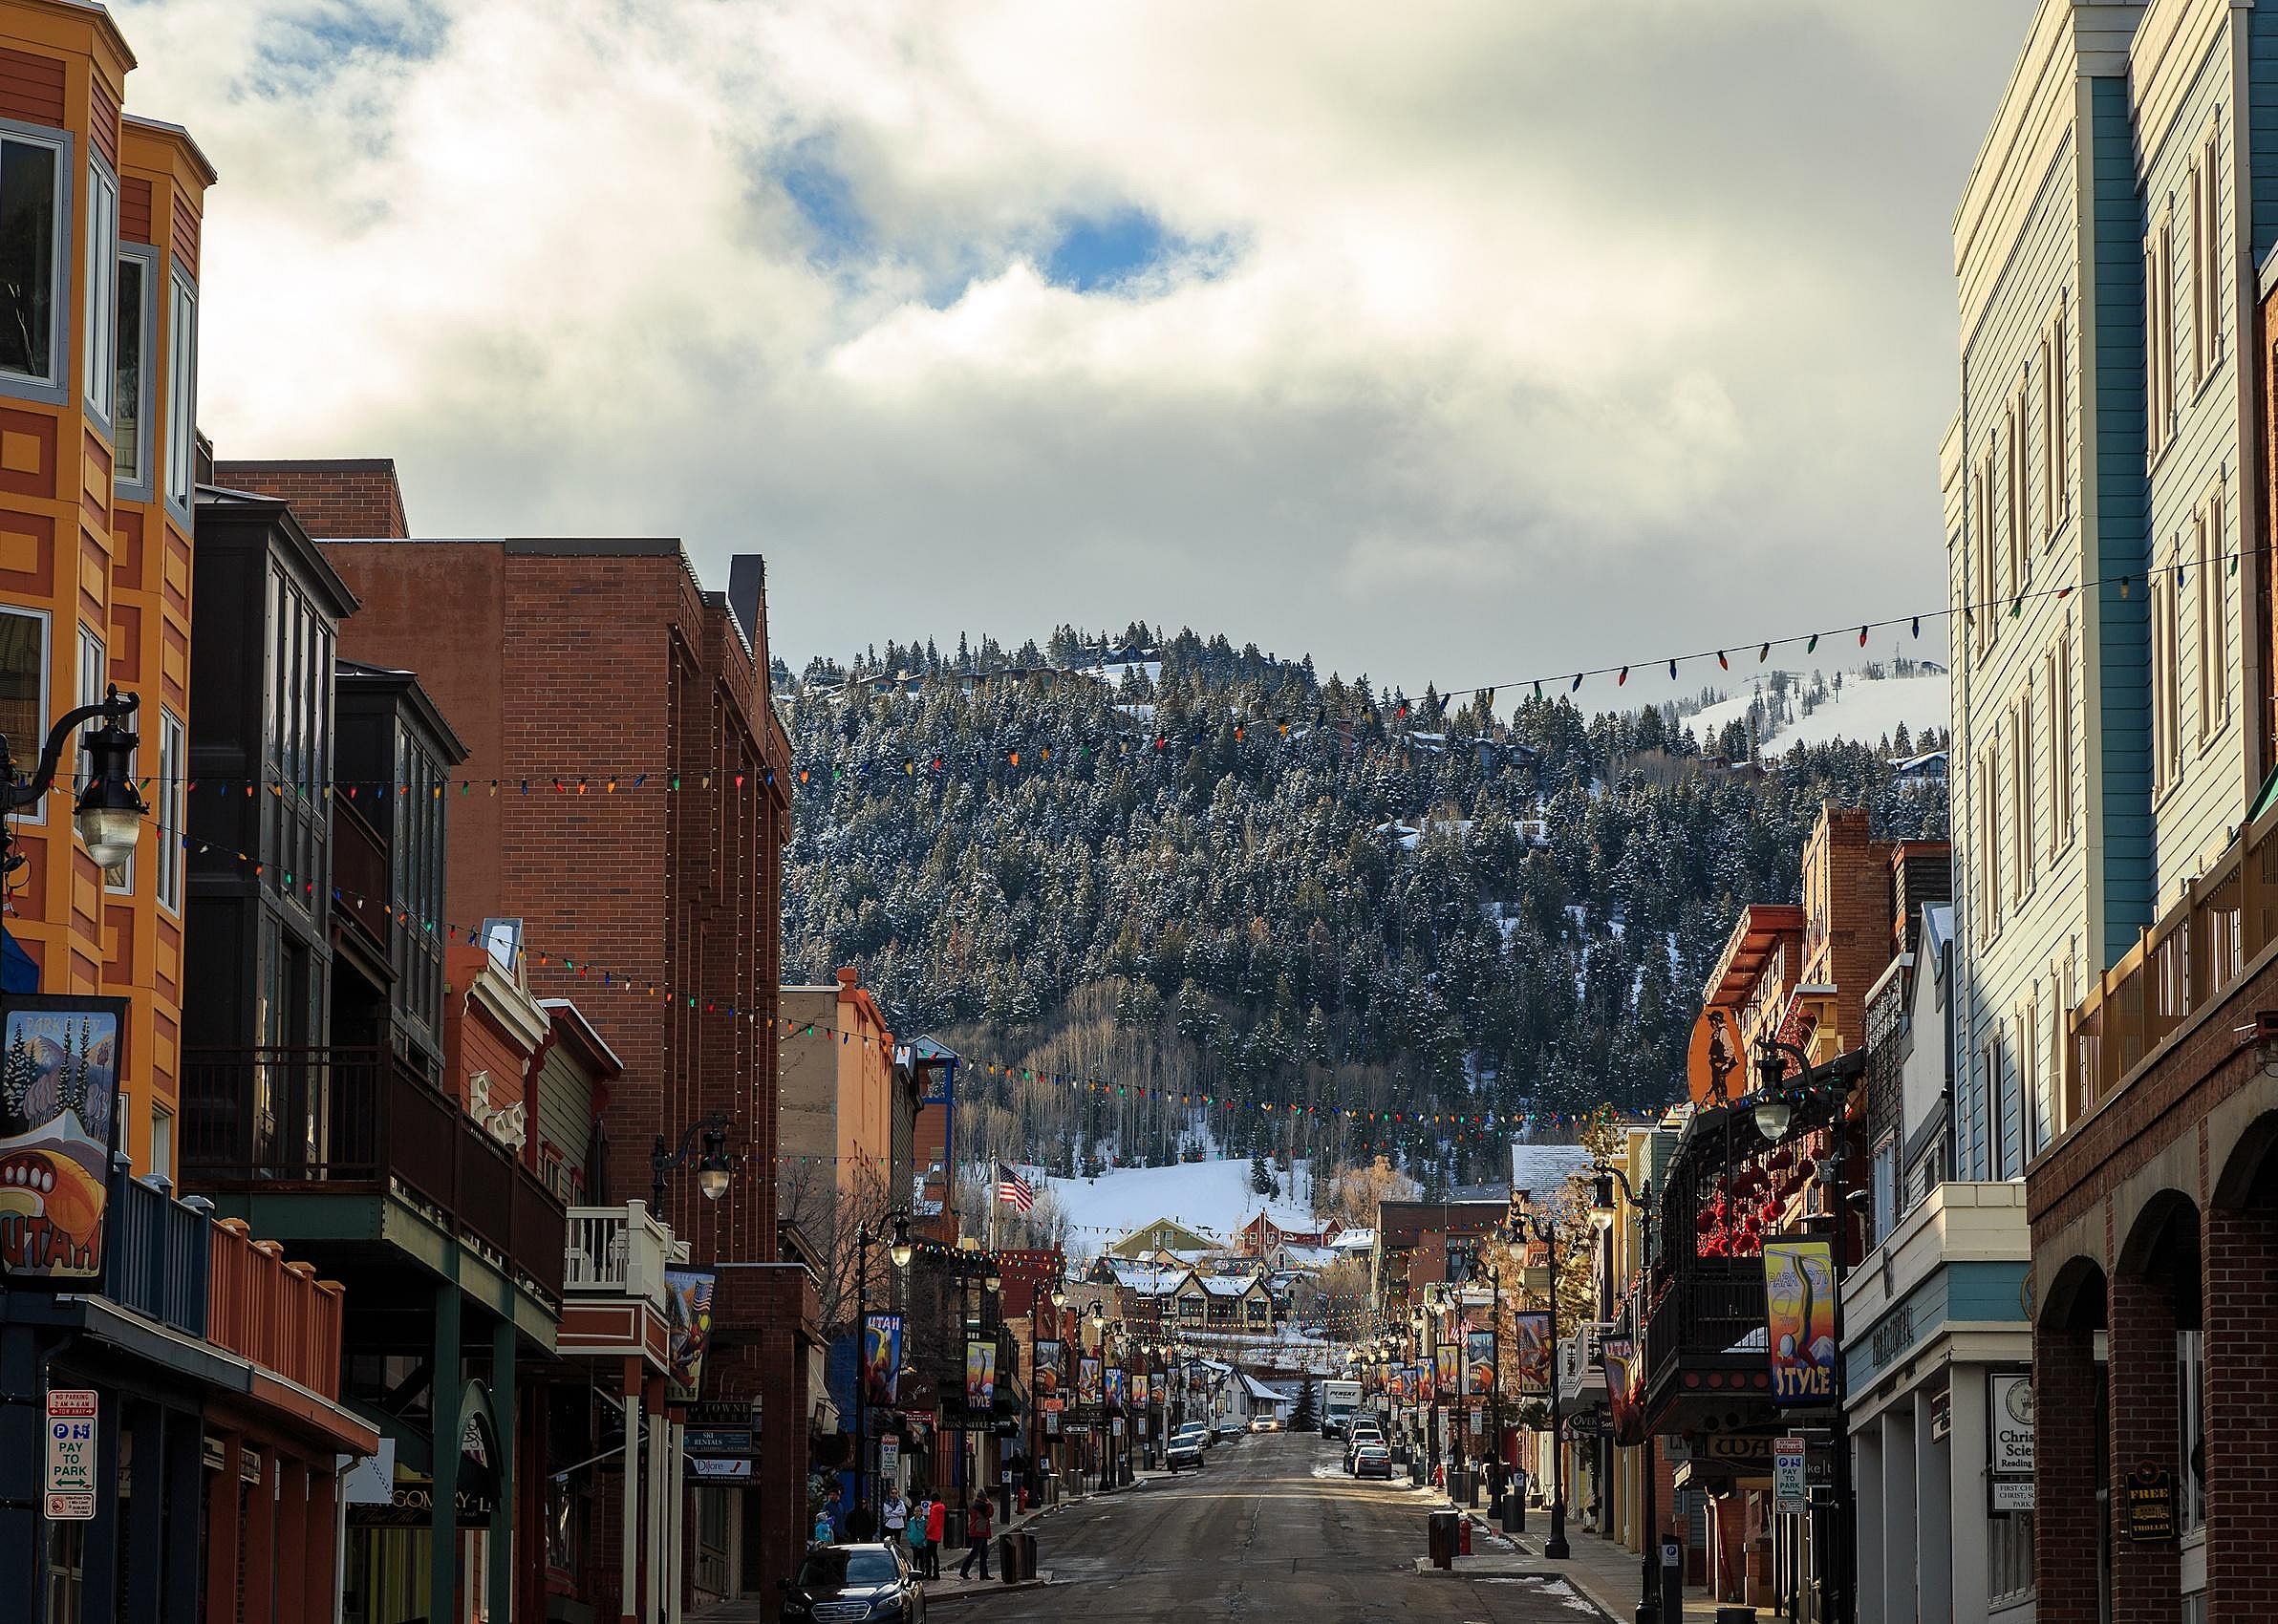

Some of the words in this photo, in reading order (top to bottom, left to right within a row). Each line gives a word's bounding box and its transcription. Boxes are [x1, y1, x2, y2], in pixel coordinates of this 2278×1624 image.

[2, 1214, 102, 1271] UTAH
[1768, 1271, 1798, 1288] PARK
[1806, 1269, 1832, 1286] CITY
[867, 1316, 900, 1331] UTAH
[1776, 1366, 1831, 1397] STYLE
[968, 1394, 991, 1407] STYLE
[705, 1403, 749, 1413] TOWNE
[1999, 1430, 2034, 1442] Chris
[58, 1442, 83, 1452] PAY
[2006, 1443, 2034, 1457] Scie
[63, 1454, 79, 1464] TO
[2001, 1459, 2032, 1468] Reading
[54, 1466, 87, 1476] PARK
[2130, 1488, 2169, 1499] FREE
[2132, 1523, 2169, 1531] TROLLEY
